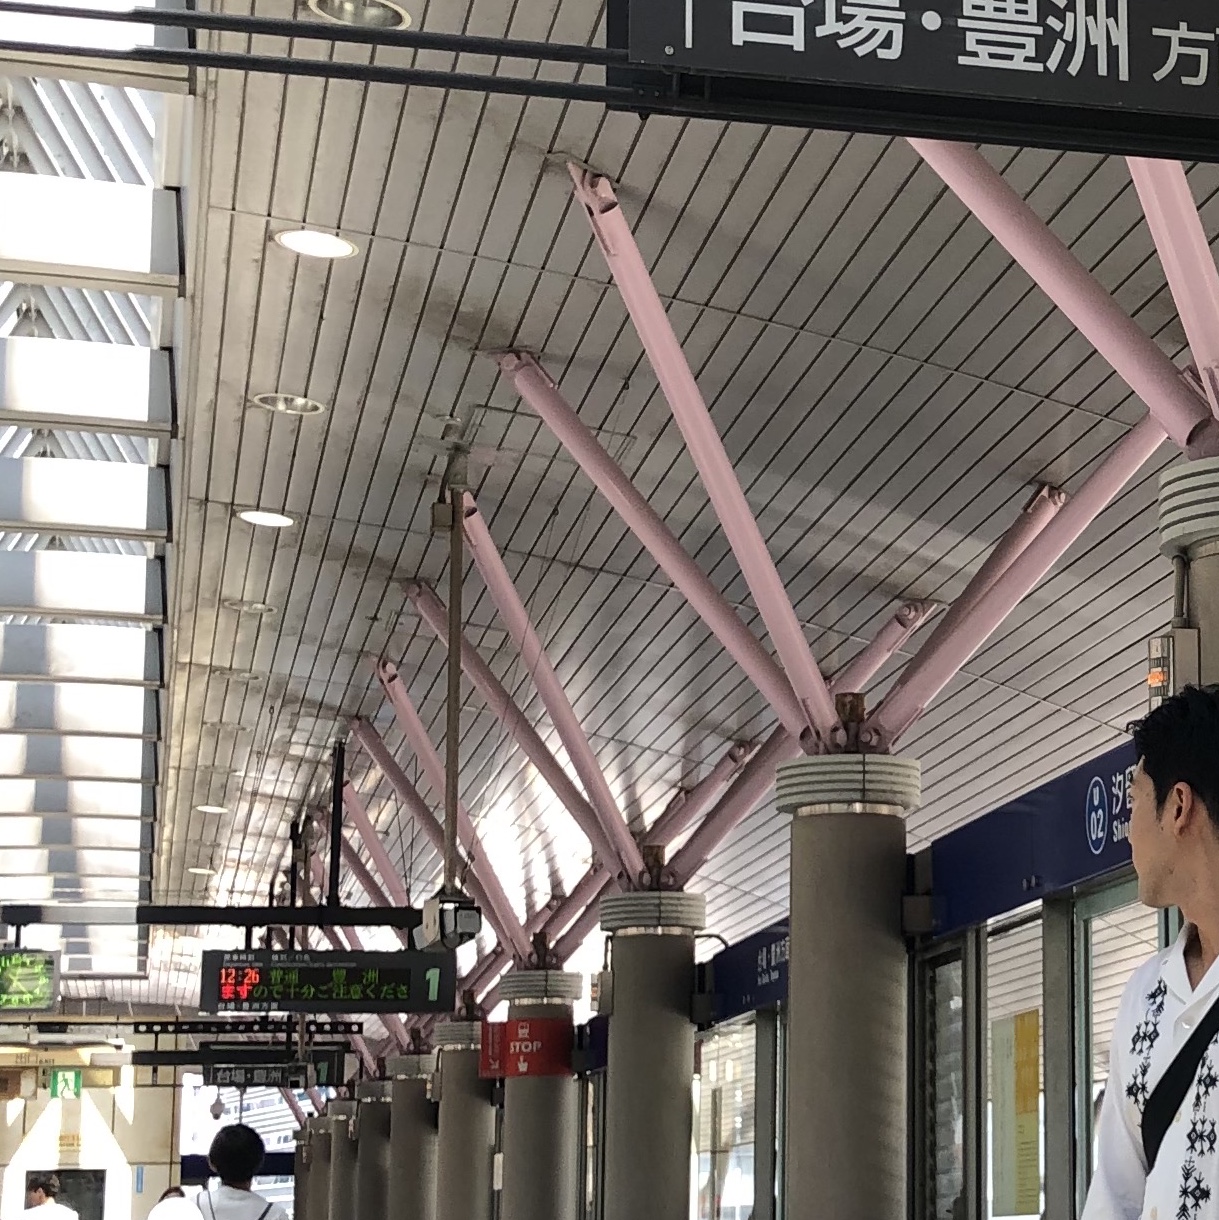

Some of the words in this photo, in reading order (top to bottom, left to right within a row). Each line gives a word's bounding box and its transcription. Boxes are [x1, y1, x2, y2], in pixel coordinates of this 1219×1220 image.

[1092, 786, 1100, 807] U
[1090, 808, 1104, 841] 02
[1112, 817, 1131, 843] Shio
[219, 968, 260, 984] 12:26
[425, 967, 441, 1001] 1
[509, 1041, 542, 1055] STOP
[317, 1061, 329, 1084] 1
